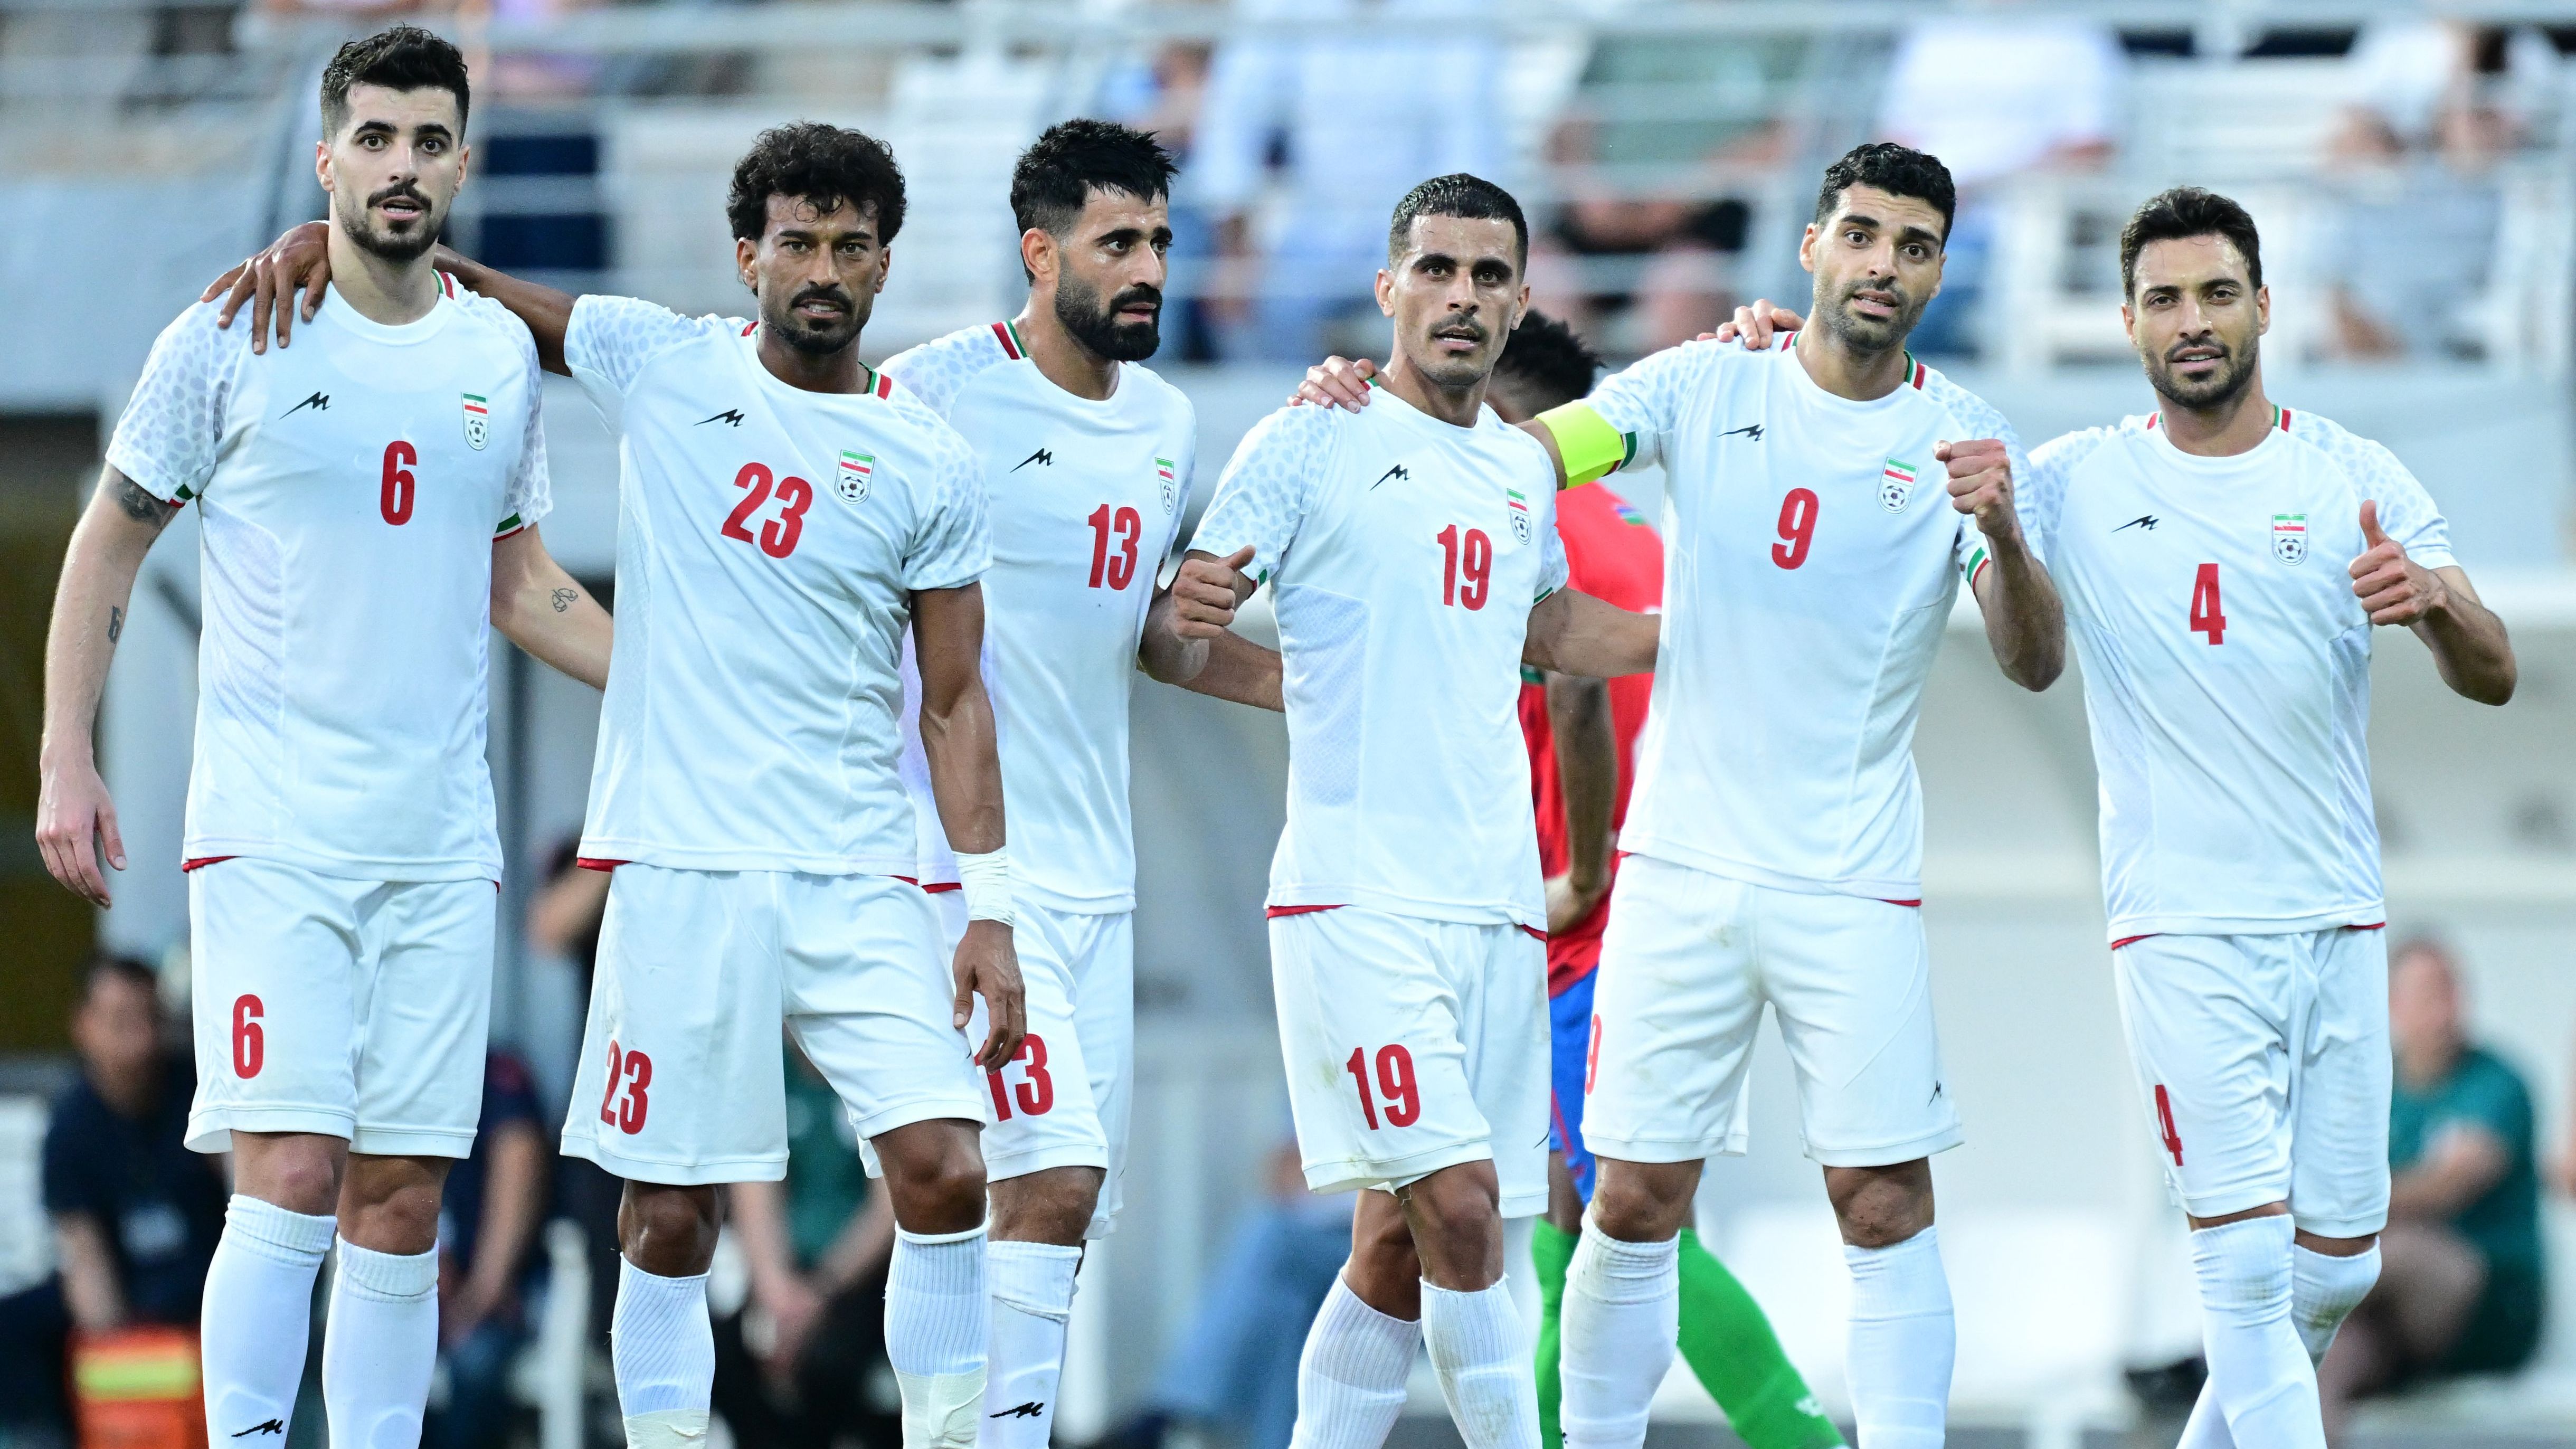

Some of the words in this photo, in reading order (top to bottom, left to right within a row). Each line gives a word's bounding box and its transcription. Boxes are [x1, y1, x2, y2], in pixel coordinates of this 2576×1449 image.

[381, 440, 418, 525] 6
[721, 462, 813, 558] 23
[1088, 504, 1141, 590] 13
[1437, 524, 1492, 611] 19
[1772, 487, 1820, 570] 9
[2190, 563, 2227, 646] 4
[232, 993, 264, 1079] 6
[973, 1033, 1054, 1122] 13
[1586, 1013, 1602, 1095] 9
[601, 1039, 652, 1135] 23
[1347, 1044, 1420, 1130] 19
[2155, 1084, 2183, 1166] 4
